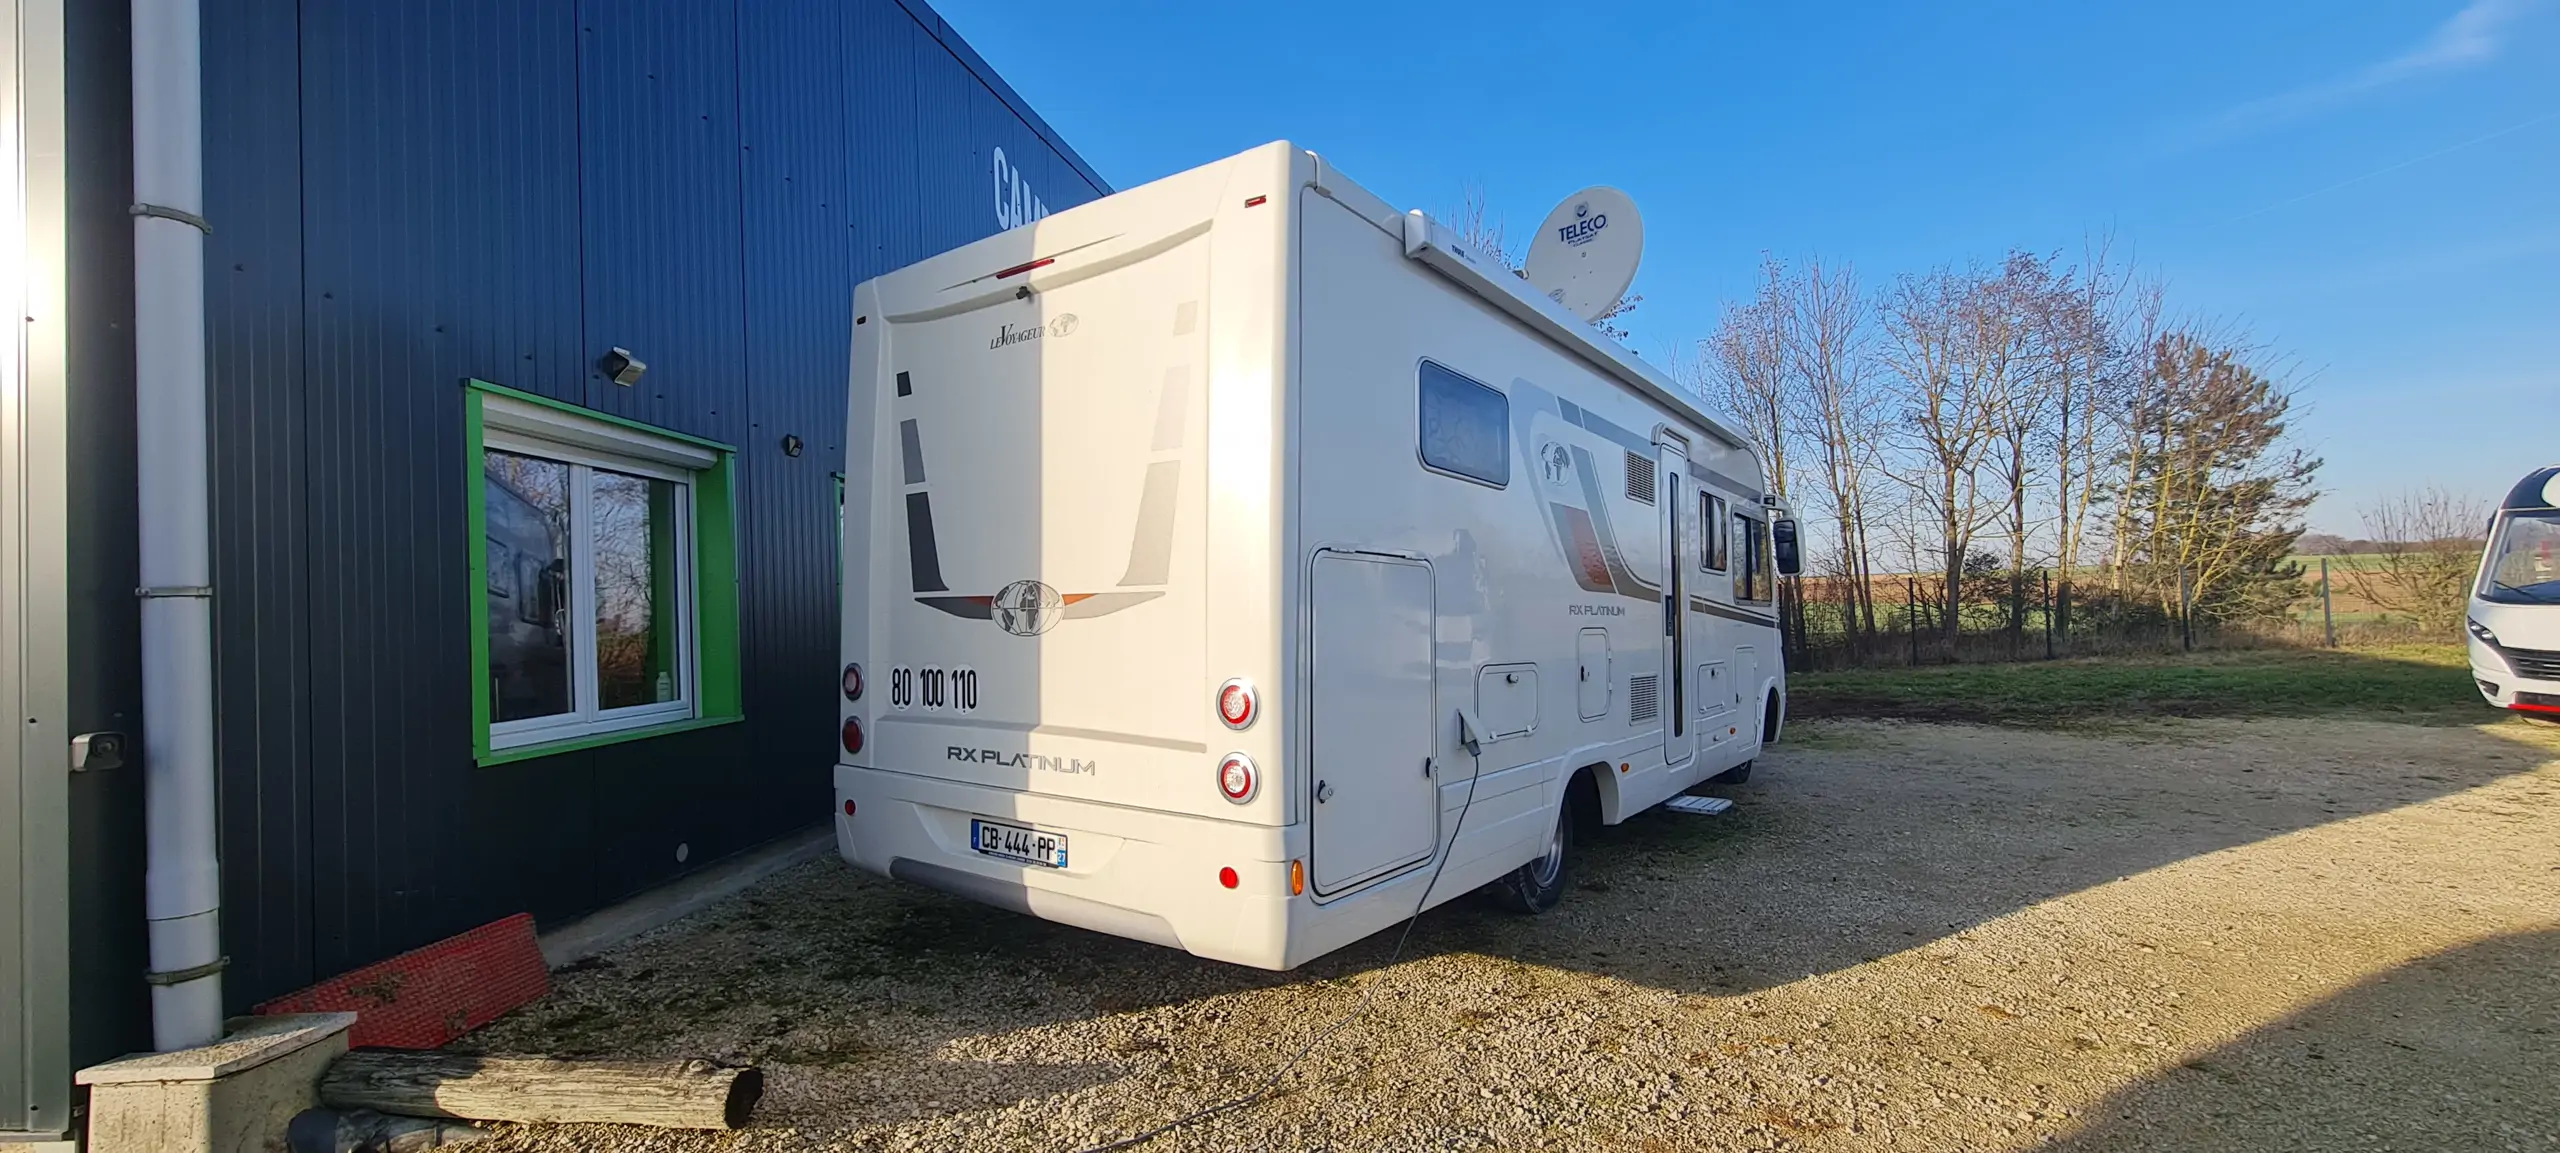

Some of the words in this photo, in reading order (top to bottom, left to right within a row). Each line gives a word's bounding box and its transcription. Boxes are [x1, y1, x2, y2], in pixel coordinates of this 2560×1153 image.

[993, 146, 1051, 231] CAM
[1558, 214, 1607, 242] TELECO
[1569, 604, 1583, 616] RX
[1584, 604, 1626, 616] PLATINUM
[891, 667, 912, 706] 80
[920, 668, 945, 708] 100
[951, 669, 977, 710] 110
[947, 746, 978, 763] RX
[981, 749, 1096, 776] PLATINUM
